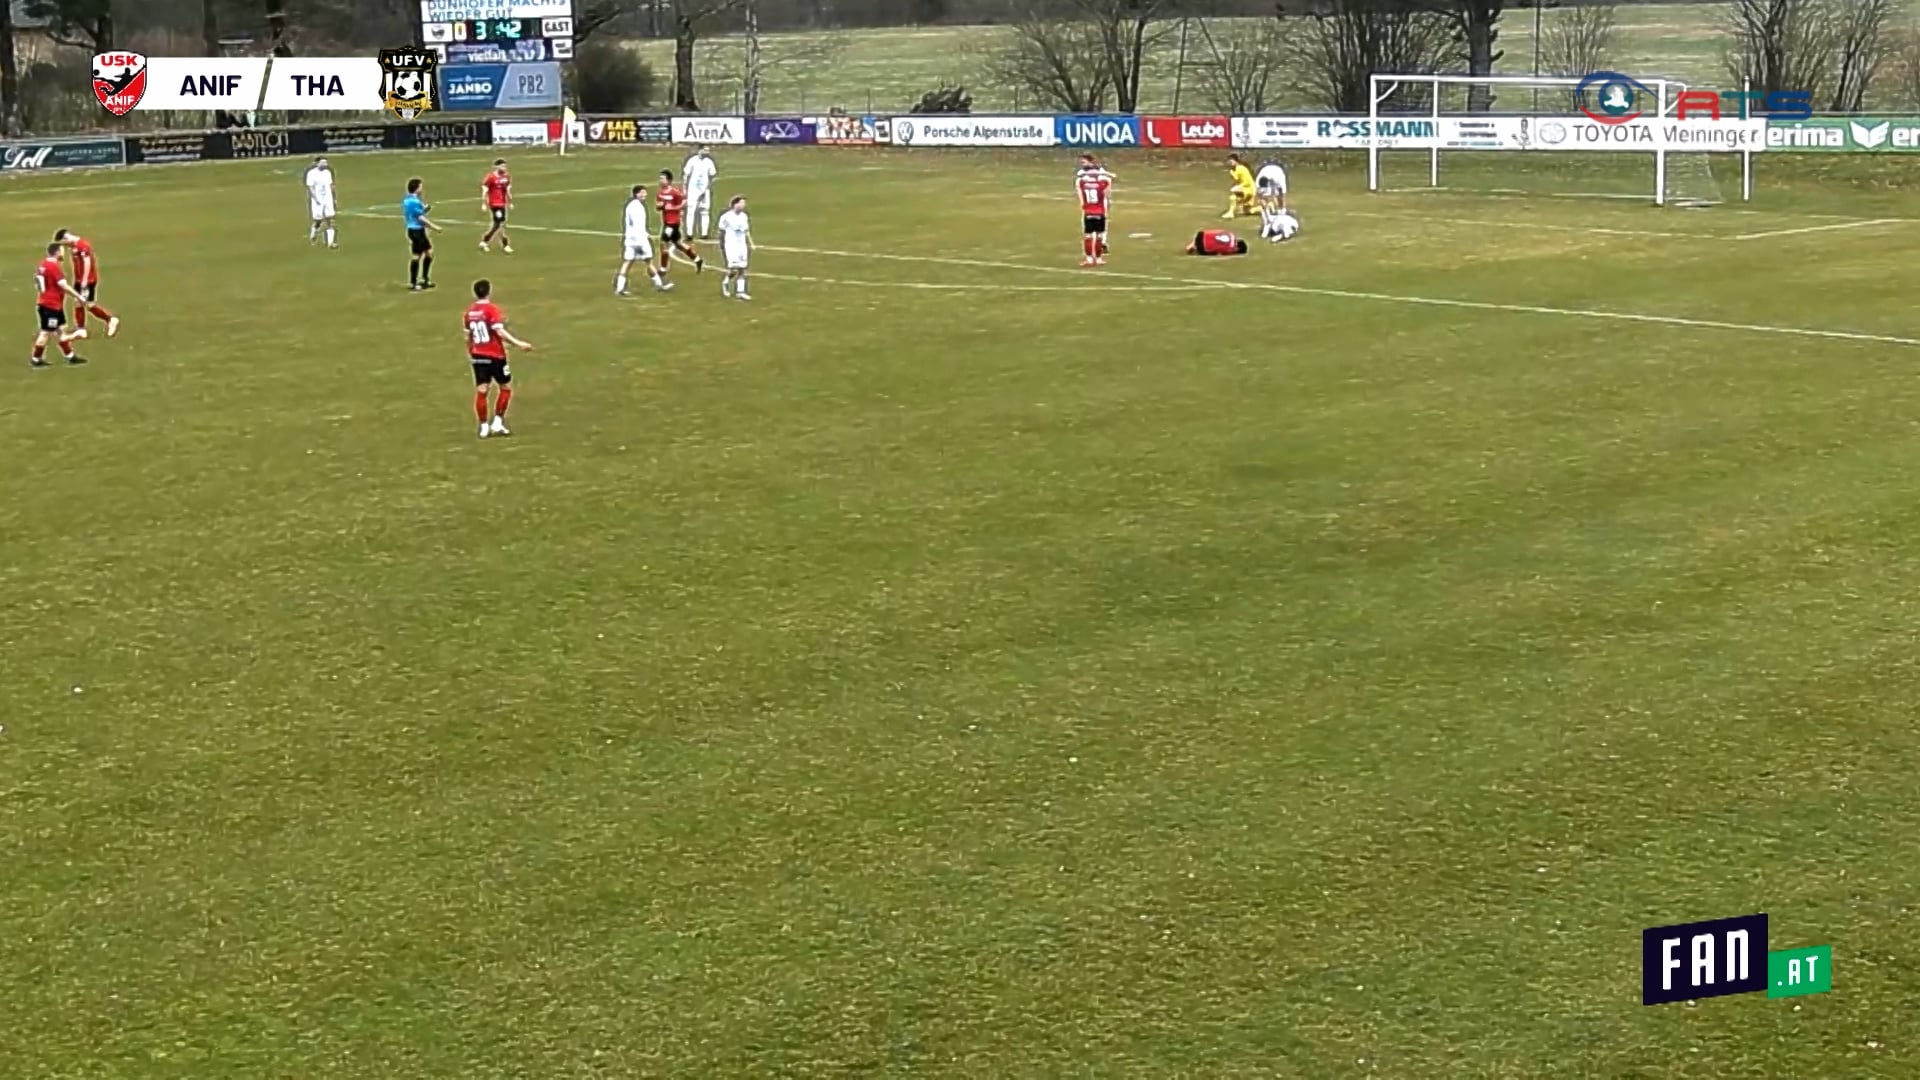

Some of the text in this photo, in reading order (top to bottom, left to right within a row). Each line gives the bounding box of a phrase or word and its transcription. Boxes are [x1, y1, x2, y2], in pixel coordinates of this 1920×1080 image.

[923, 125, 1044, 140] Porsche Alpenstraße
[1065, 121, 1136, 144] UNIQA
[1181, 121, 1226, 138] Leube
[1573, 125, 1654, 142] TOYOTA
[1767, 123, 1844, 146] erima
